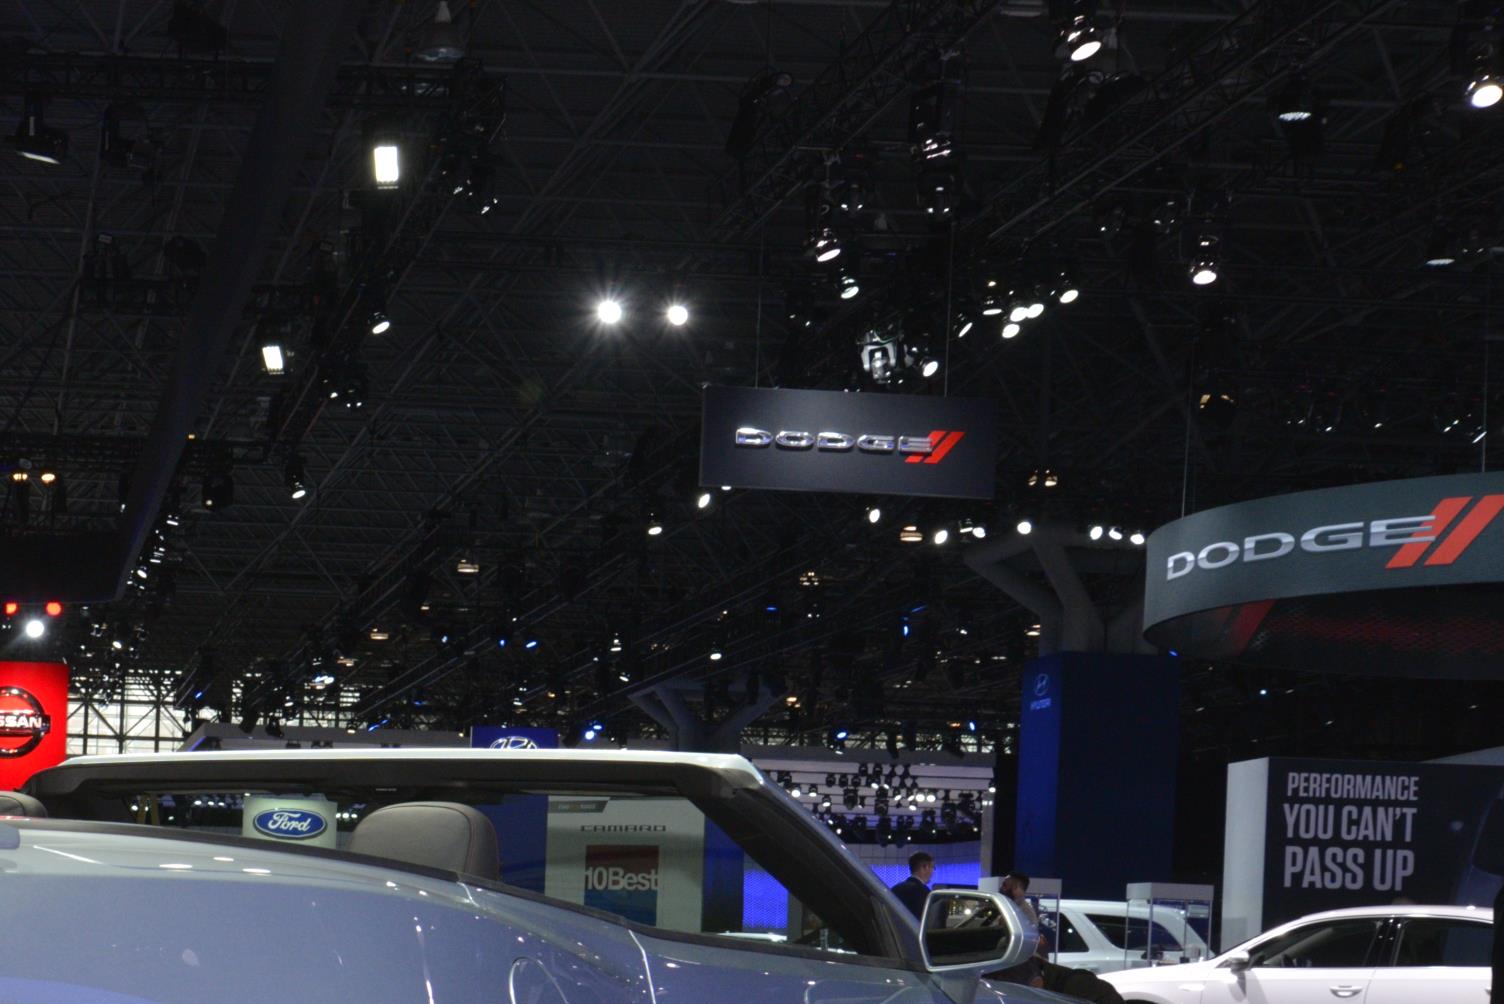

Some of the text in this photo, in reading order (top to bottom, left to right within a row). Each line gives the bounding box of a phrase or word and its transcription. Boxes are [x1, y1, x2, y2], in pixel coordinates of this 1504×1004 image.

[735, 427, 933, 452] DODGE
[1166, 515, 1436, 580] DODGE
[1287, 772, 1419, 801] PERFORMANCE
[267, 811, 312, 832] Ford
[580, 824, 667, 832] CAMARO
[1282, 803, 1417, 842] YOU CAN'T
[584, 866, 660, 891] 10Best
[1283, 845, 1415, 891] PASS UP
